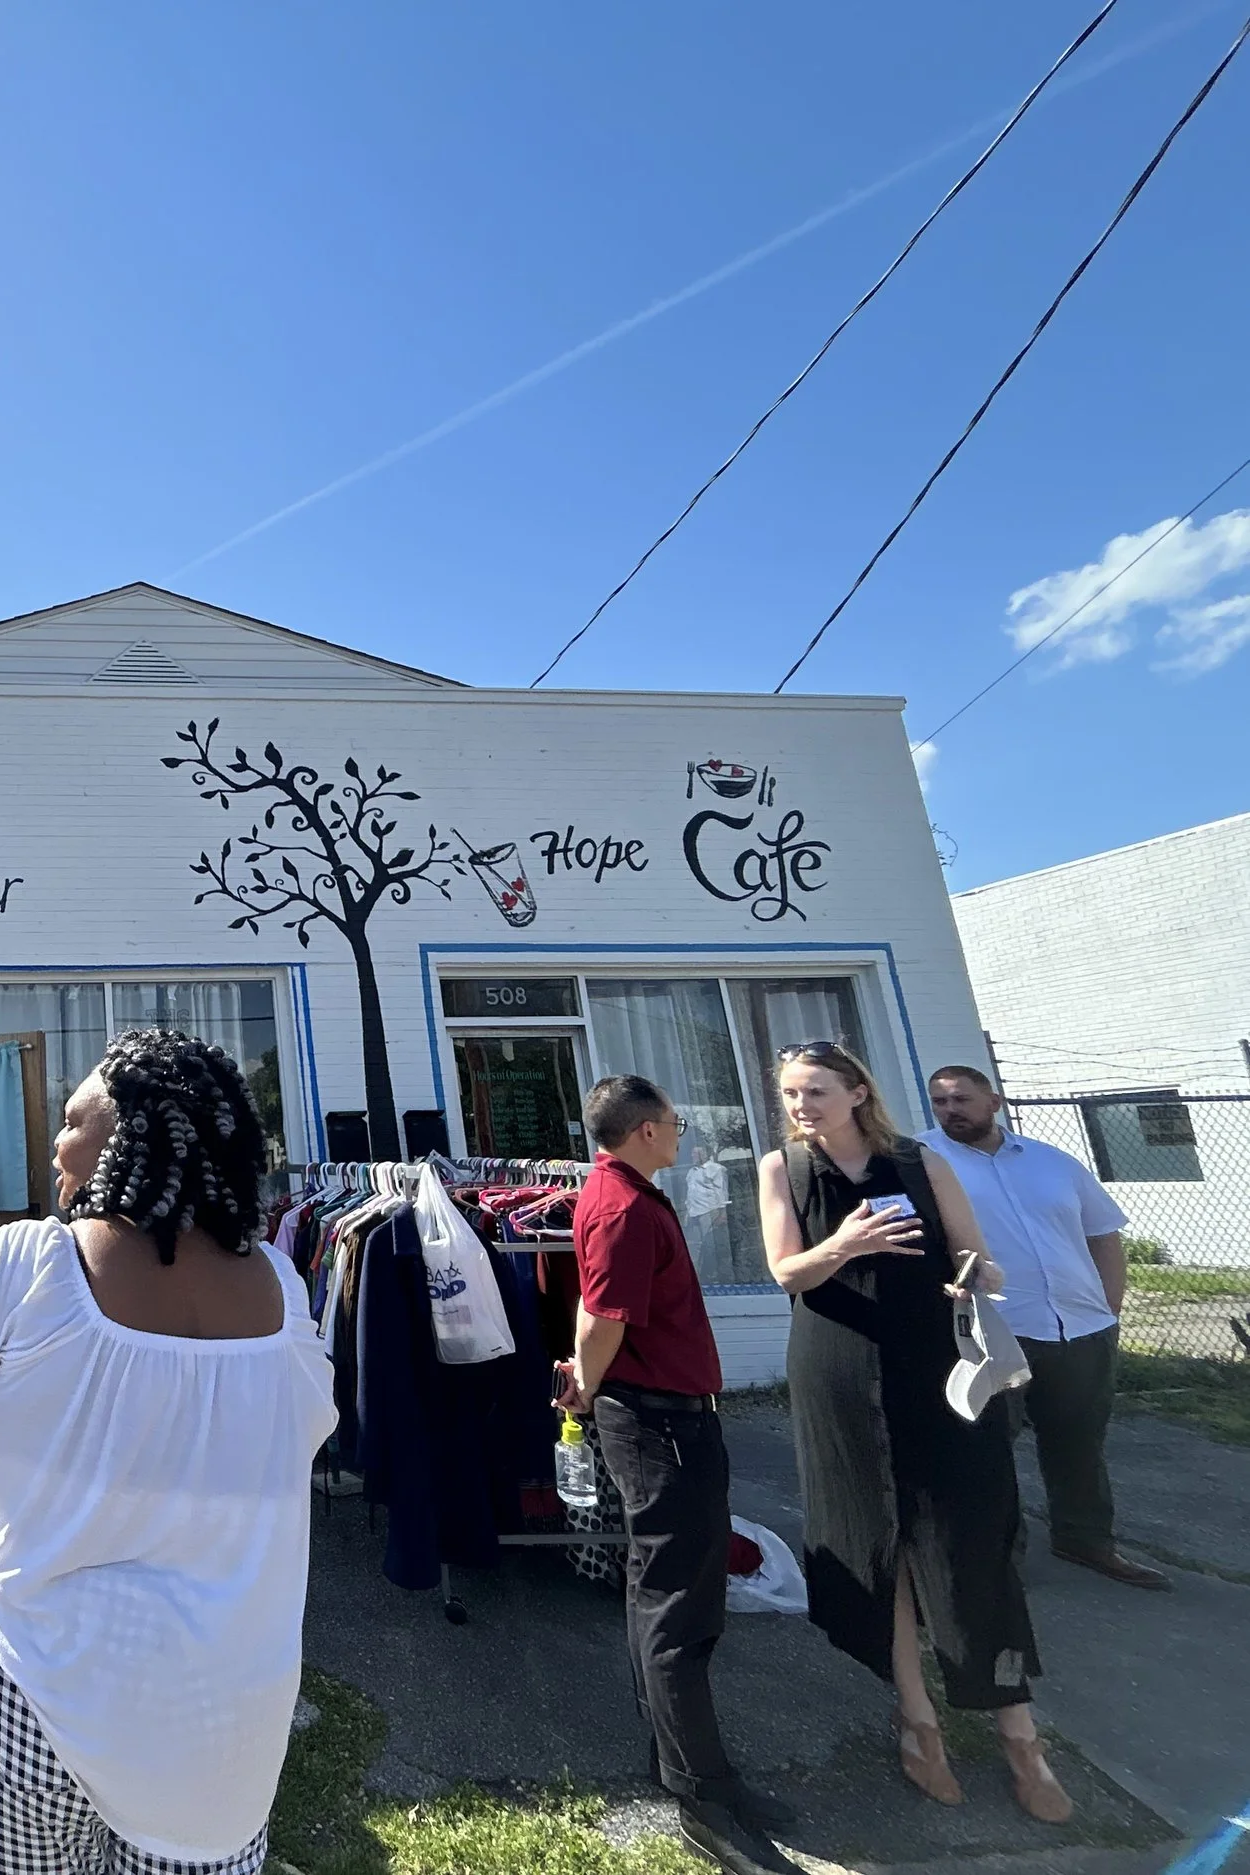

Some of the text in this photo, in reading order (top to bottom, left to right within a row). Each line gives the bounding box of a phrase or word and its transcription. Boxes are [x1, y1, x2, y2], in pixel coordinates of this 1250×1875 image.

[529, 809, 832, 923] Hope Cafe
[485, 986, 527, 1005] 508
